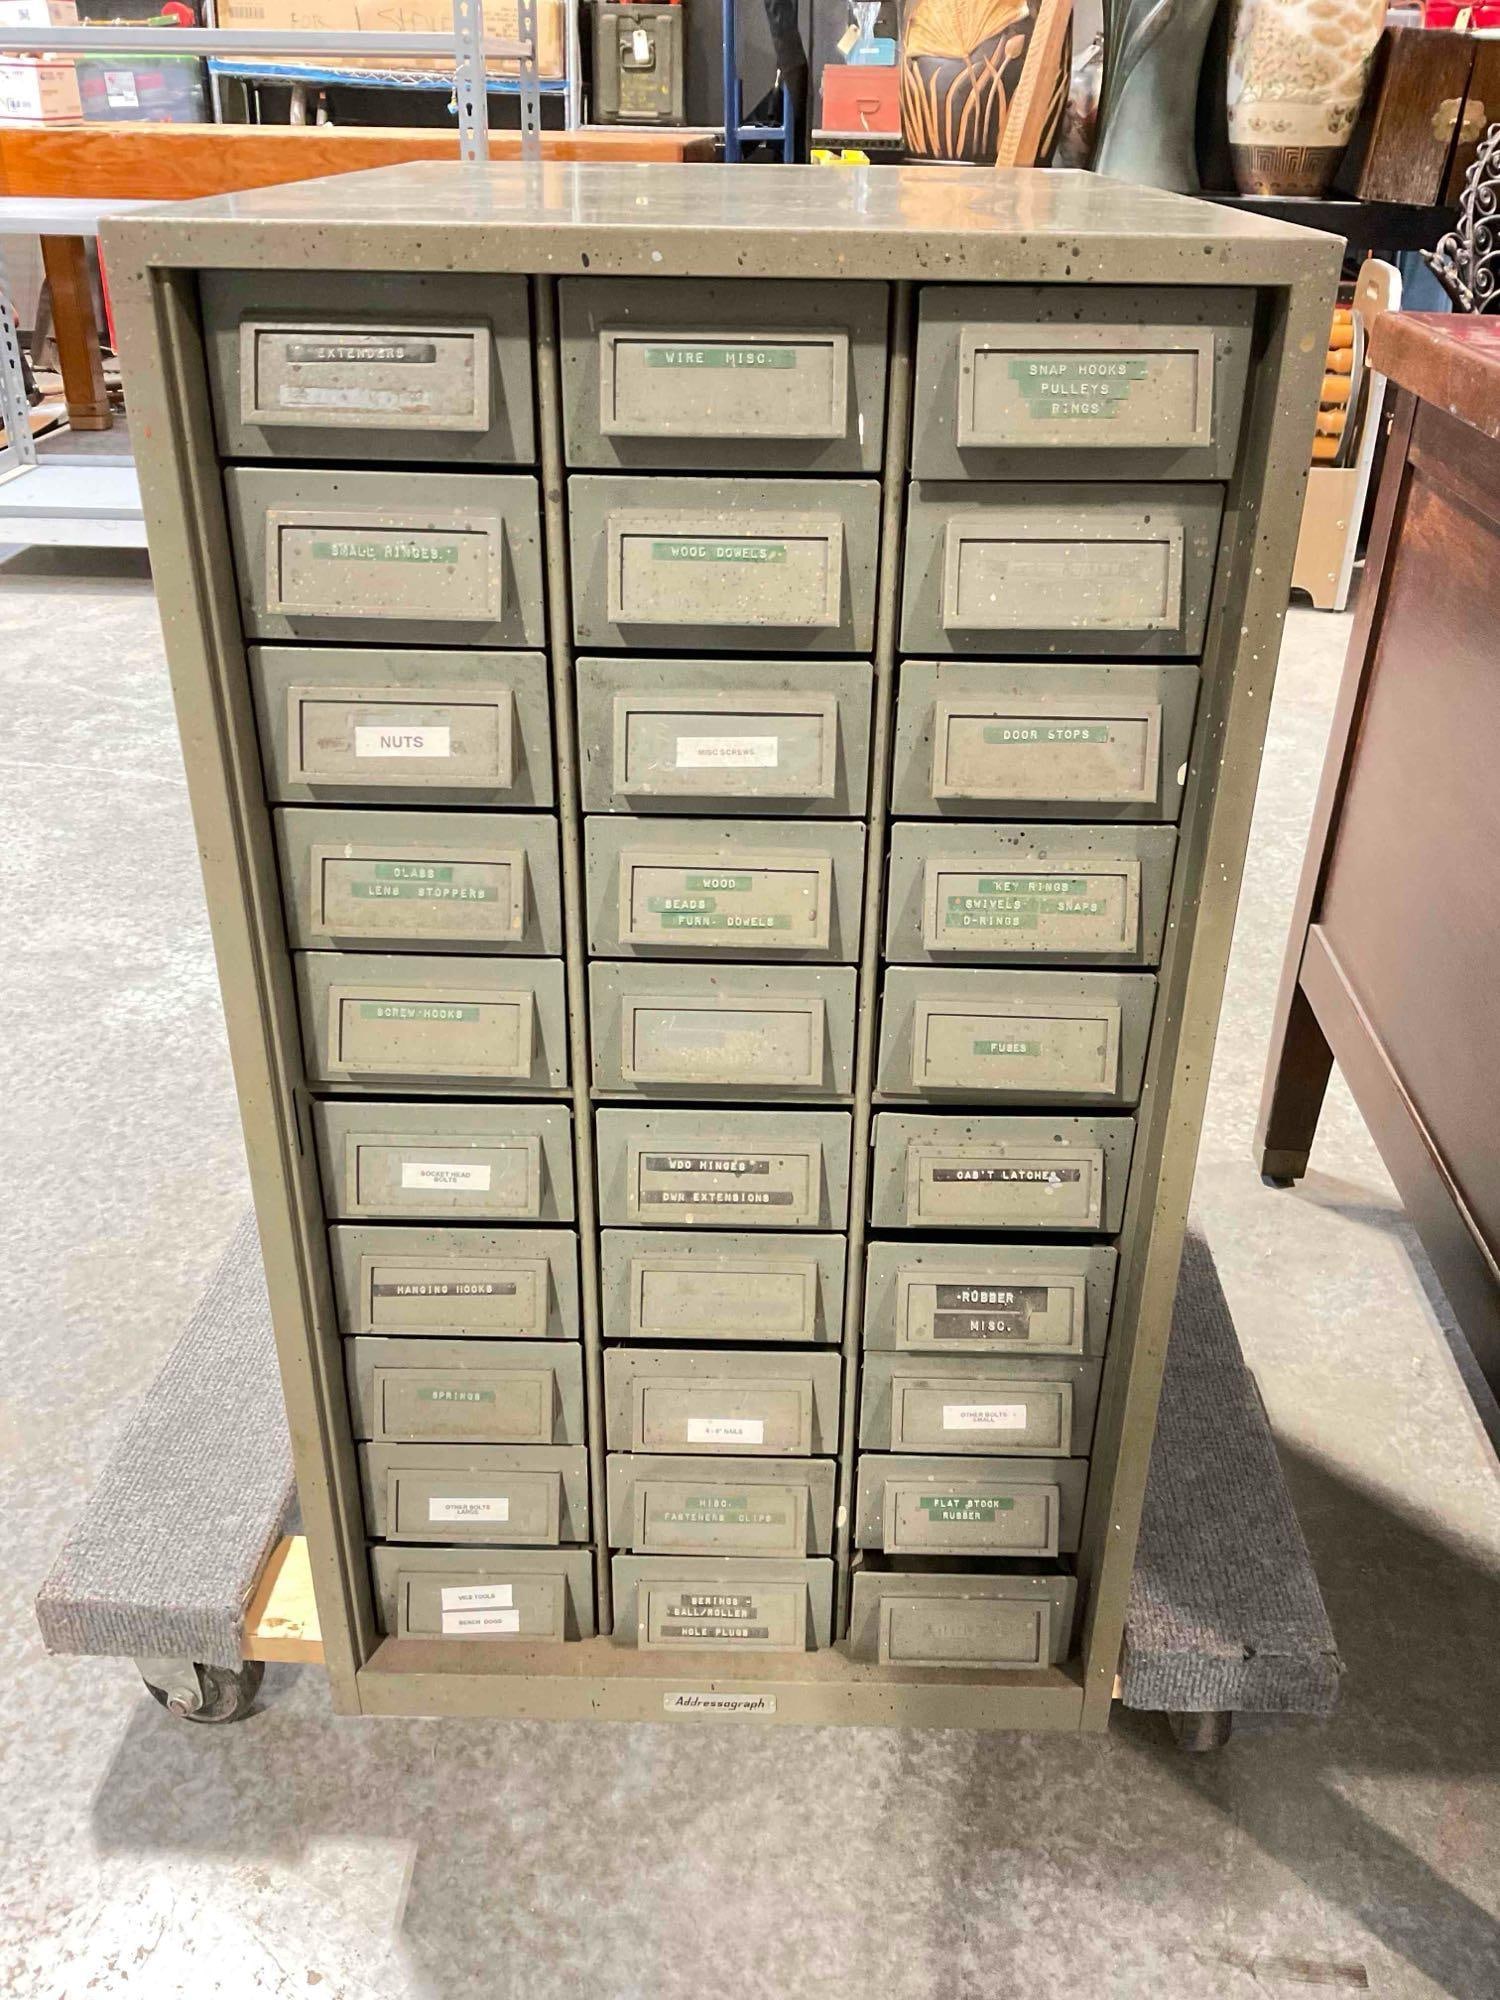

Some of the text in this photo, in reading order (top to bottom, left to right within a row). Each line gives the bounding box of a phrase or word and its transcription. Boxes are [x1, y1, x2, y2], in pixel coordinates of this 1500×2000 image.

[316, 346, 406, 359] EXTENDERS
[665, 352, 774, 366] WIRE MISC.
[1028, 363, 1128, 377] SNAP HOOKS
[1040, 383, 1110, 396] PULLEYS
[1051, 402, 1101, 415] RINGS
[330, 544, 376, 558] SMALL
[671, 546, 707, 558] WOOD
[1003, 729, 1091, 741] DOOR STOPS
[380, 735, 425, 749] NUTS
[393, 867, 436, 880] GLASS
[702, 878, 737, 889] WOOD
[994, 881, 1070, 893] KEY RINGS
[367, 886, 486, 900] LENS STOPPERS
[664, 898, 707, 911] BEADS
[965, 899, 1098, 913] SWIVELS SNAPS
[726, 916, 775, 928] DOWELS
[963, 915, 1021, 926] D-RINGS
[423, 1008, 464, 1020] HOOKS
[990, 1042, 1027, 1053] FUSES
[699, 1161, 746, 1172] HINGES
[450, 1171, 471, 1179] HEAD
[956, 1169, 1057, 1181] CAB'T LATCHES
[693, 1191, 770, 1204] EXTENSIONS
[396, 1284, 493, 1295] HANGING HOOKS
[969, 1319, 1012, 1332] MISC.
[934, 1499, 1001, 1509] FLAT STOCK
[664, 1511, 725, 1522] FASTENERS
[942, 1511, 981, 1521] RUBBER
[674, 1607, 748, 1618] BALL/ROLLER
[681, 1627, 749, 1637] HOLE PLUGS
